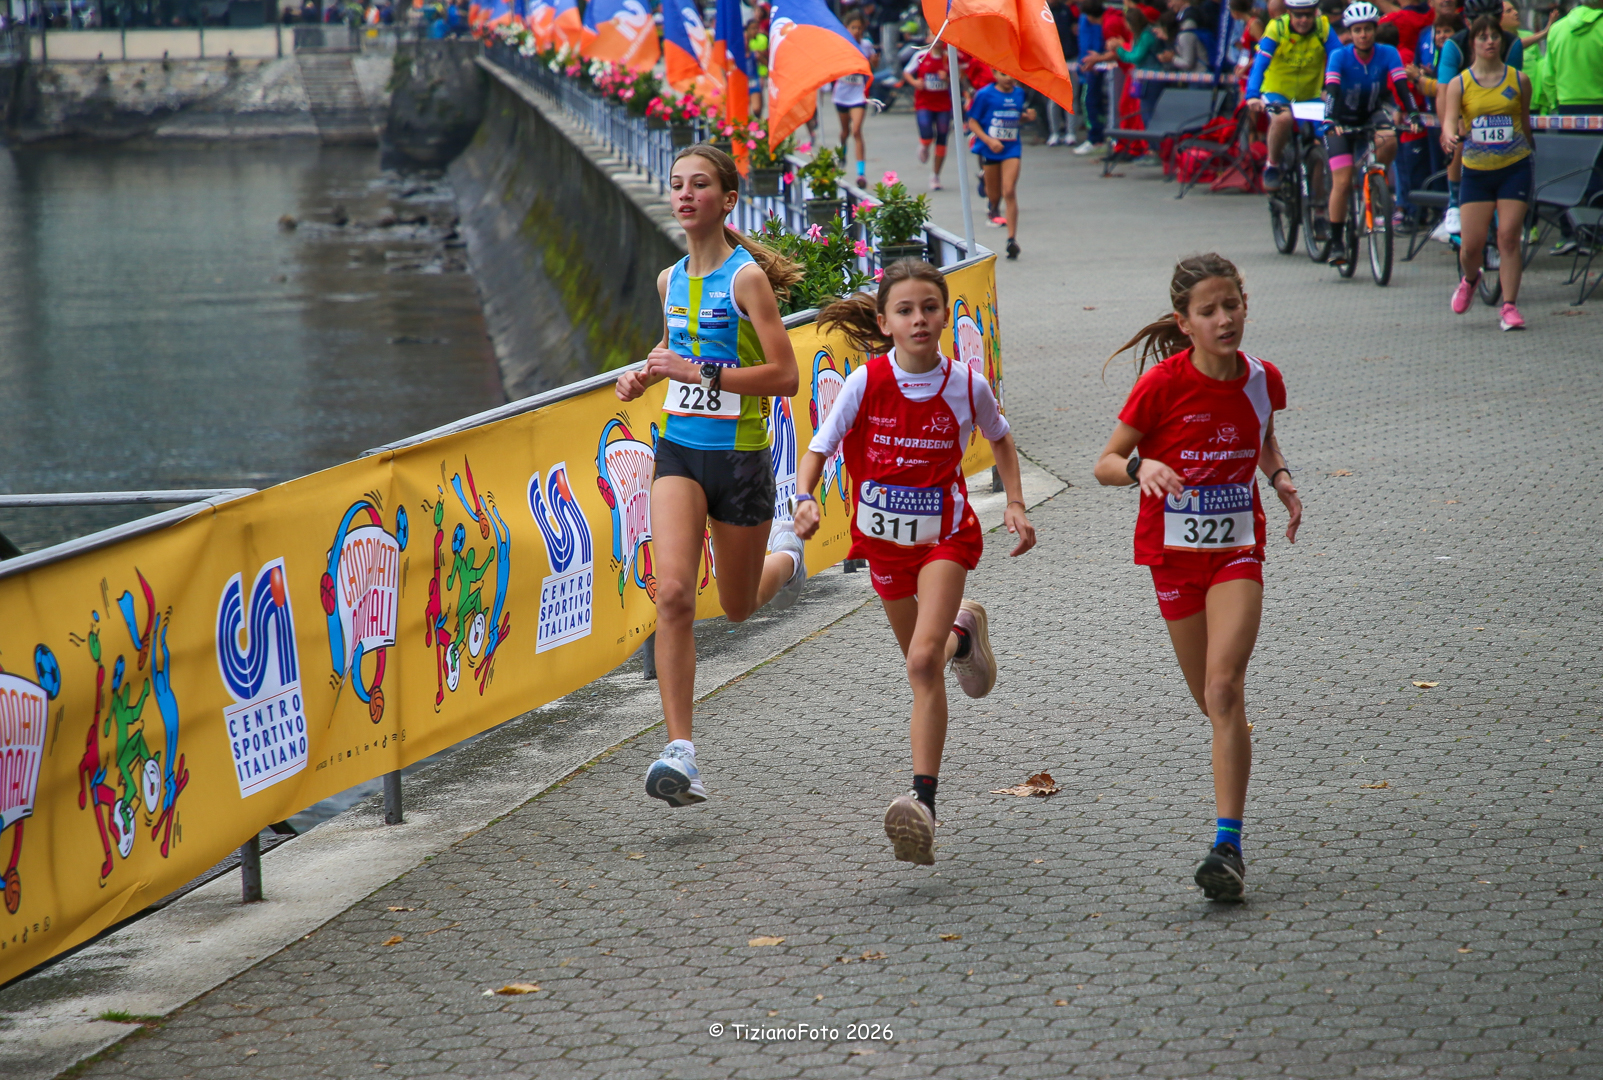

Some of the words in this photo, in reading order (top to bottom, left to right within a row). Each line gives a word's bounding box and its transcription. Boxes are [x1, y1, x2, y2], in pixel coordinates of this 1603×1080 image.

[996, 129, 1013, 138] 576
[1480, 129, 1504, 141] 148
[679, 385, 721, 412] 228
[873, 433, 891, 445] CSI
[894, 437, 954, 449] MORBEGNO
[1180, 450, 1199, 460] CSI
[1202, 449, 1256, 461] MORBEGNO
[891, 490, 940, 499] CENTRO
[1204, 488, 1248, 497] CENTRO
[1204, 494, 1250, 504] SPORTIVO
[890, 497, 940, 505] SPORTIVO
[890, 503, 940, 511] ITALIANO
[1204, 500, 1250, 510] ITALIANO
[871, 512, 918, 542] 311
[1184, 517, 1235, 544] 322
[542, 572, 592, 604] CENTRO
[540, 590, 591, 622] SPORTIVO
[538, 608, 591, 641] ITALIANO
[229, 693, 301, 738] CENTRO
[233, 715, 304, 761] SPORTIVO
[237, 736, 306, 783] ITALIANO
